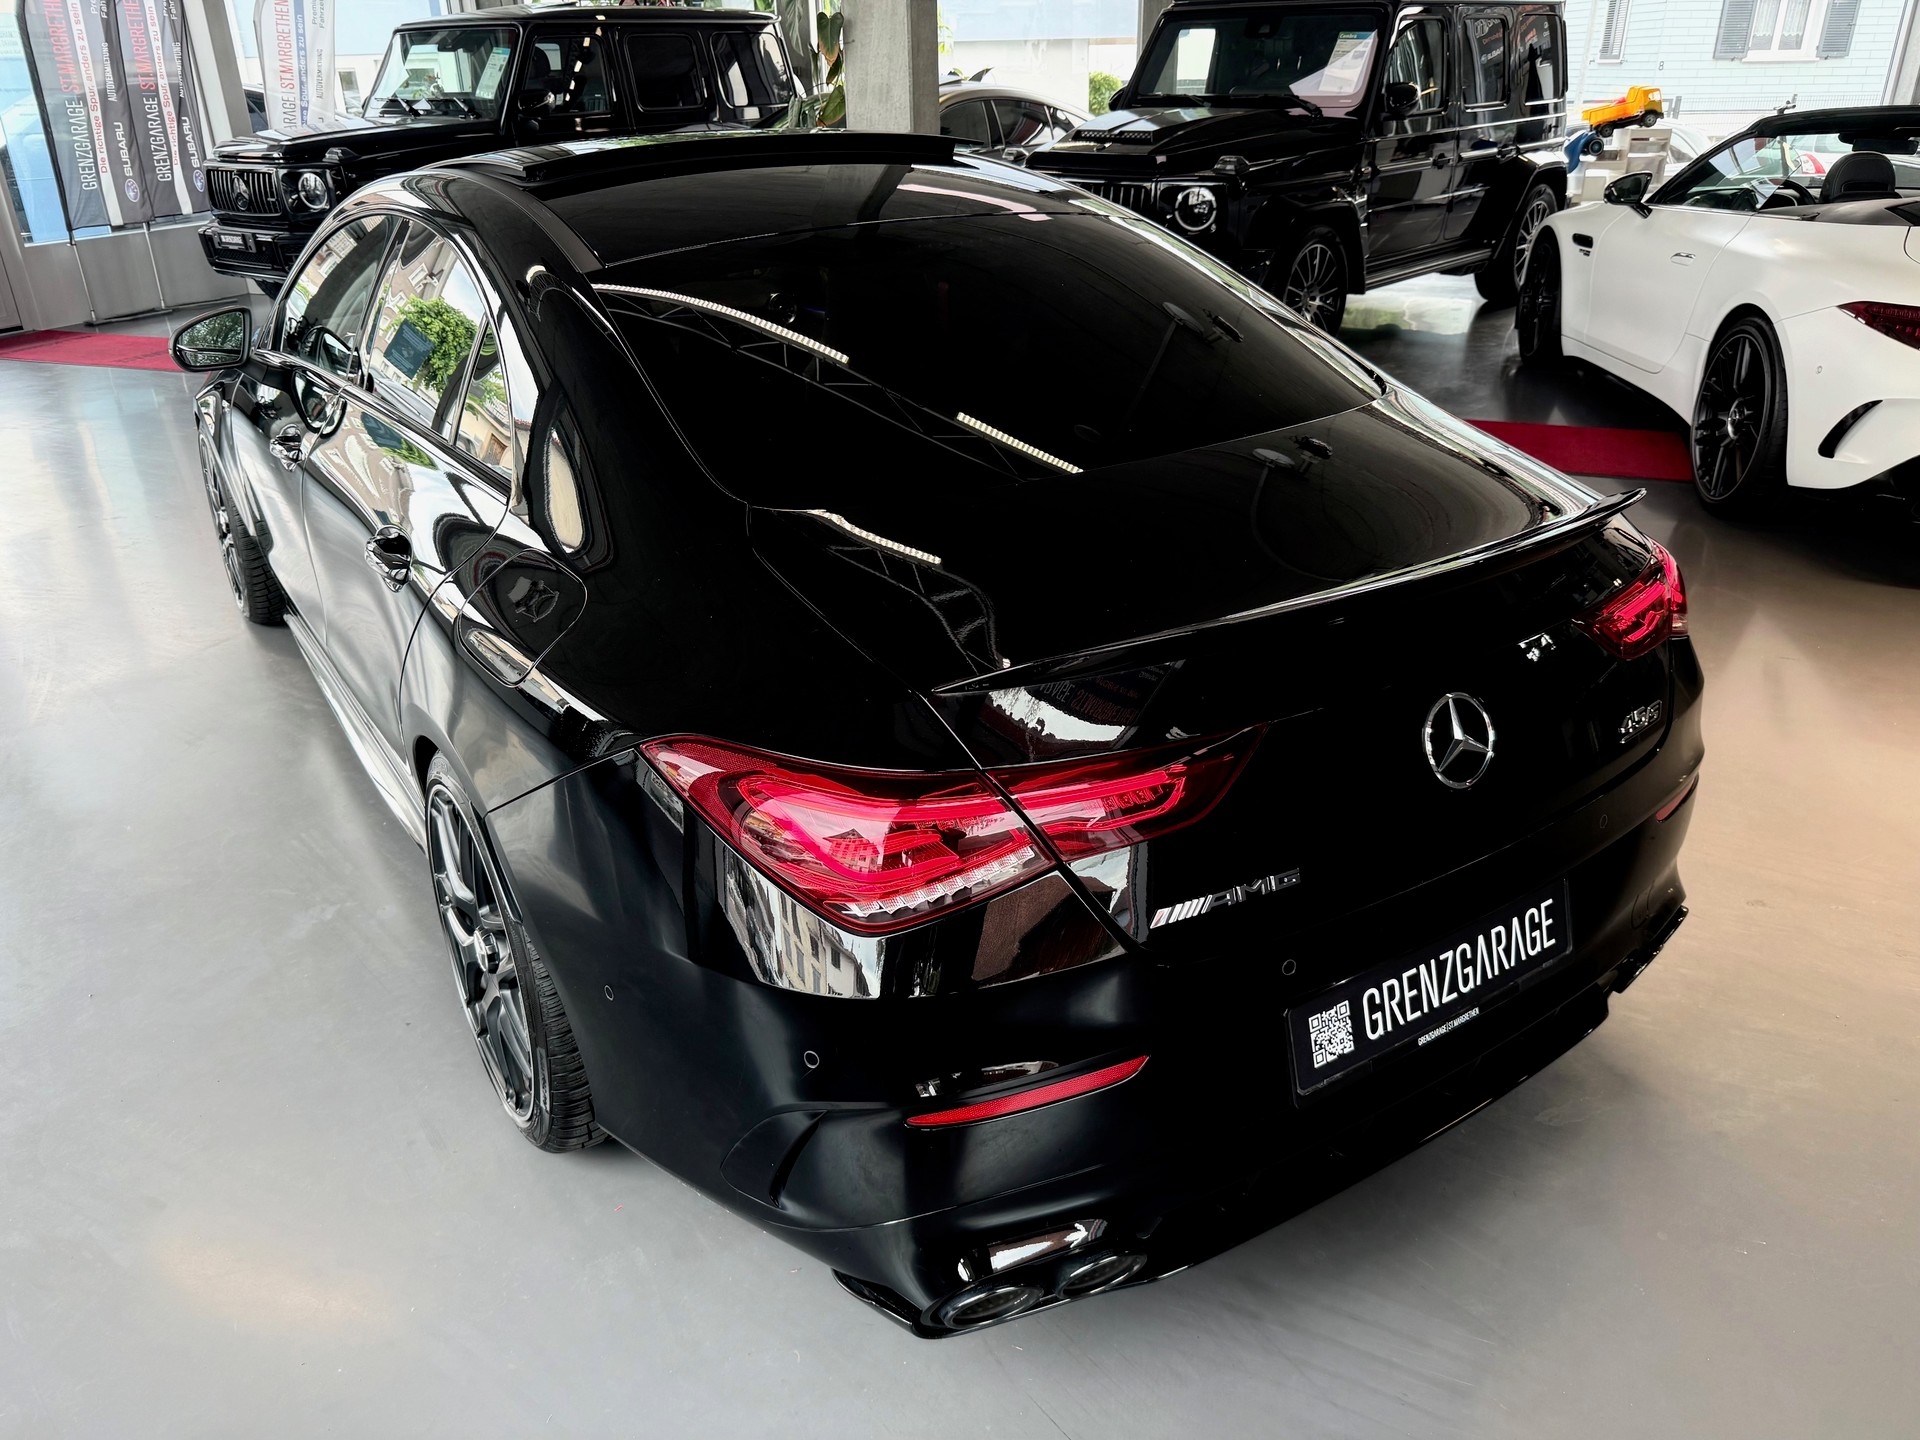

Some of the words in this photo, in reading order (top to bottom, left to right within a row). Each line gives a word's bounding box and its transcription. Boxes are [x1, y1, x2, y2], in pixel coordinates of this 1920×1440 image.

[70, 2, 81, 25] sein
[147, 6, 157, 27] sein
[296, 14, 304, 34] sein
[75, 28, 86, 41] zu
[152, 30, 161, 42] zu
[298, 36, 306, 48] zu
[80, 45, 93, 82] anders
[102, 42, 118, 102] AUTOVERMIETUNG
[156, 45, 165, 80] anders
[299, 50, 307, 83] anders
[1658, 60, 1664, 71] 8
[87, 85, 99, 112] Spur,
[160, 83, 171, 108] Spur,
[65, 100, 98, 191] GRENZGARAGE
[93, 115, 105, 153] richtige
[143, 97, 172, 182] GRENZGARAGE
[165, 110, 178, 148] richtige
[181, 116, 201, 168] SUBARU
[100, 155, 109, 174] Die
[113, 121, 134, 177] SUBARU
[171, 150, 179, 166] Die
[1200, 867, 1301, 914] AMG
[1362, 898, 1556, 1041] GRENZGARAGE
